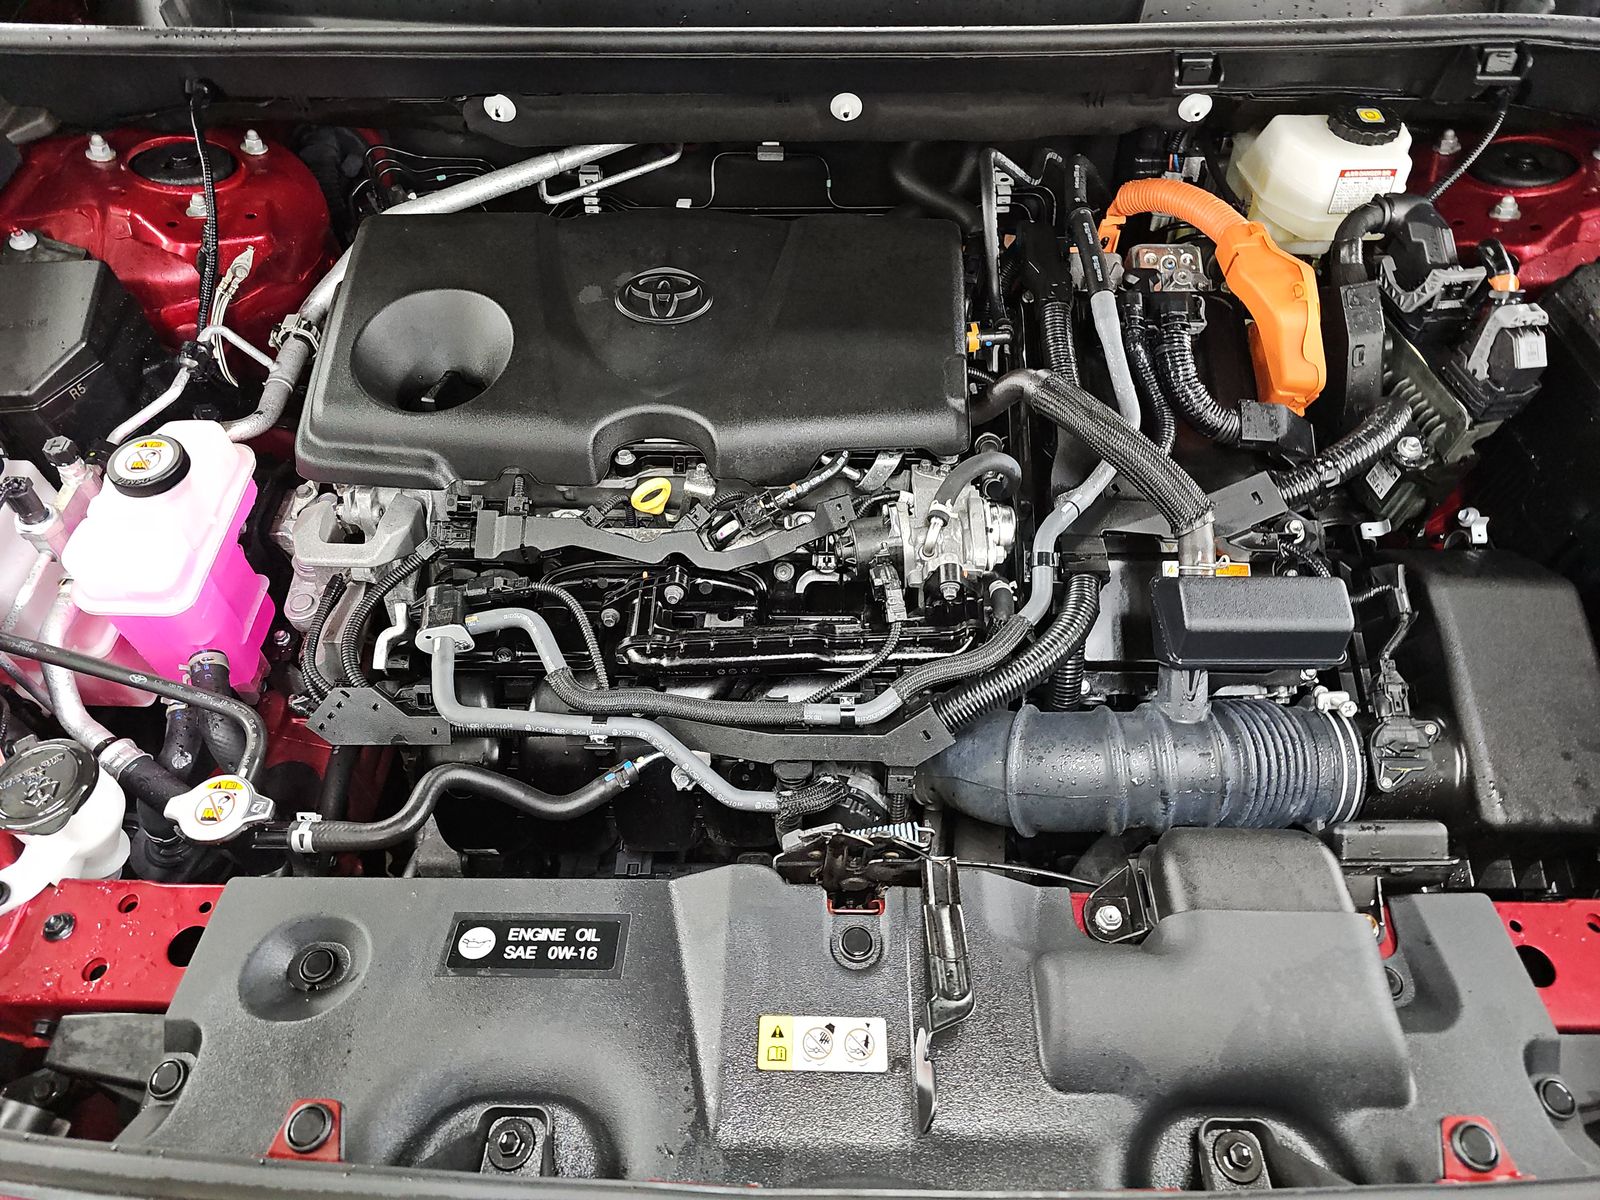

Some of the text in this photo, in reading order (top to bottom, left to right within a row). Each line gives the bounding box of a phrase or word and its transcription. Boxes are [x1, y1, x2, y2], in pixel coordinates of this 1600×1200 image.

[68, 383, 87, 401] R5
[507, 927, 601, 942] ENGINE OIL
[503, 945, 598, 960] SAE 0W-16
